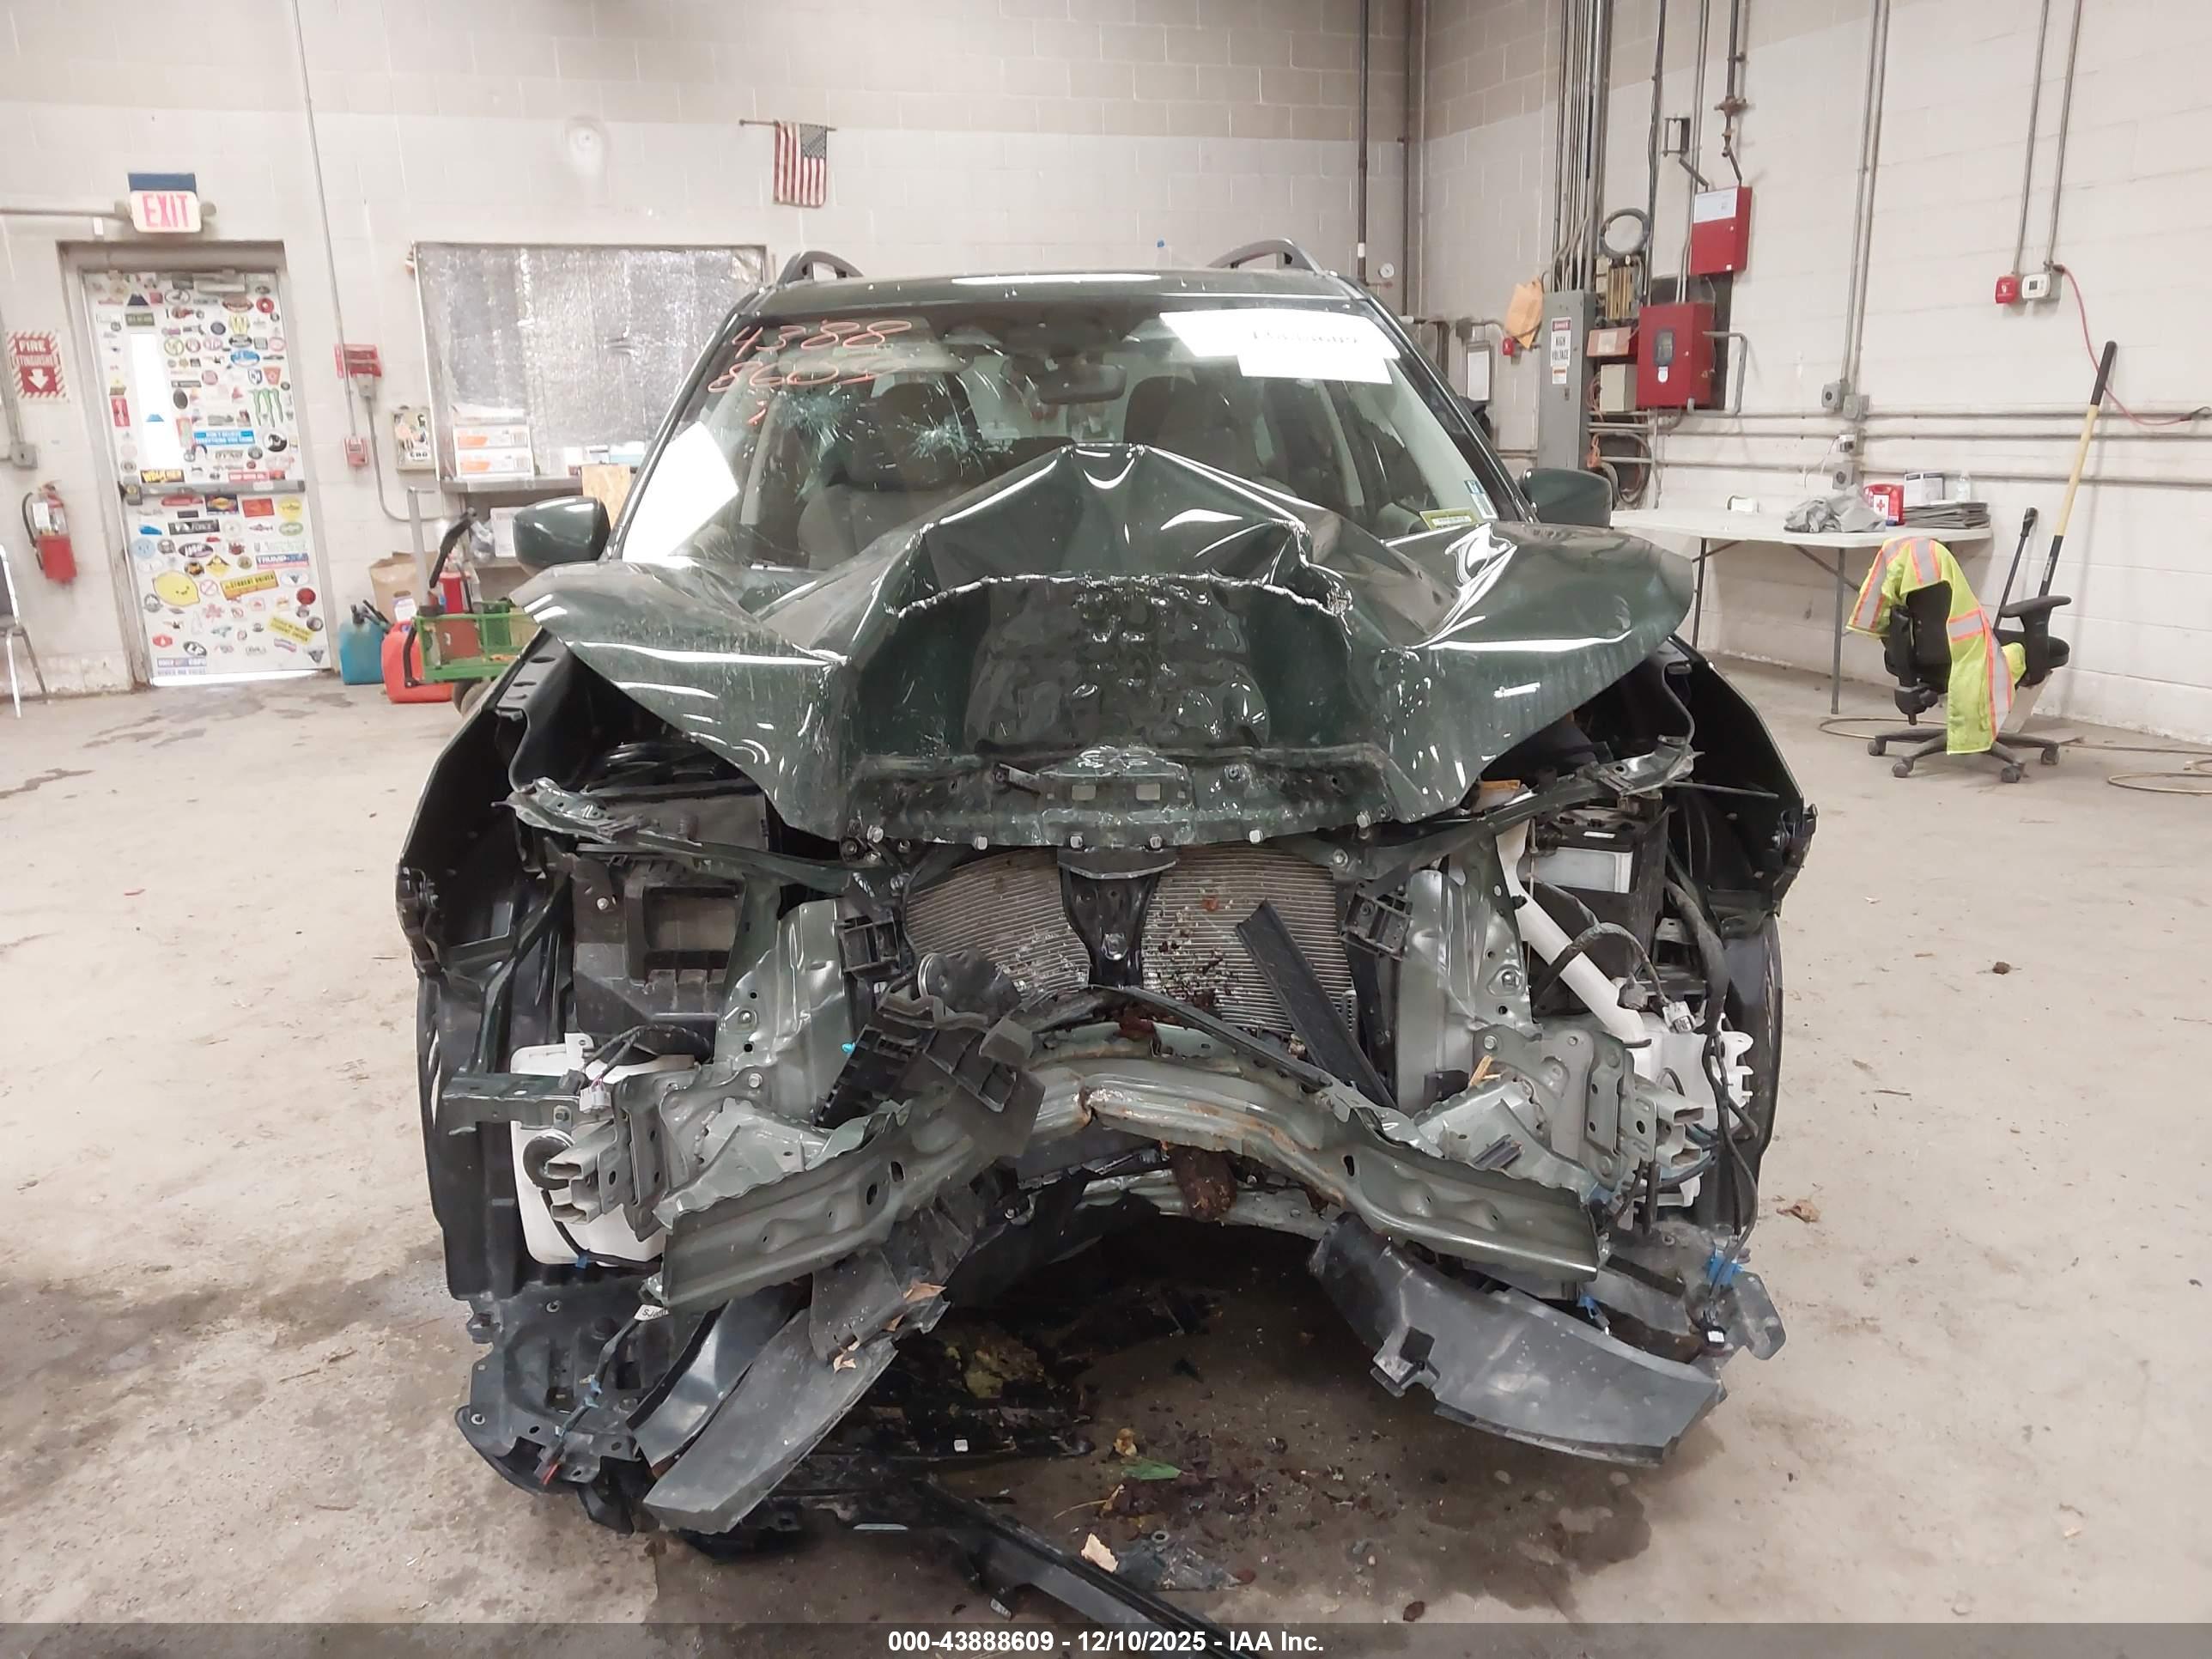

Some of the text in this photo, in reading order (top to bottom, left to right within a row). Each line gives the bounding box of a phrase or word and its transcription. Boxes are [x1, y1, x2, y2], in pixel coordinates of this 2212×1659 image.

[142, 192, 188, 227] EXIT
[19, 340, 46, 352] FIRE
[731, 320, 913, 360] 4388
